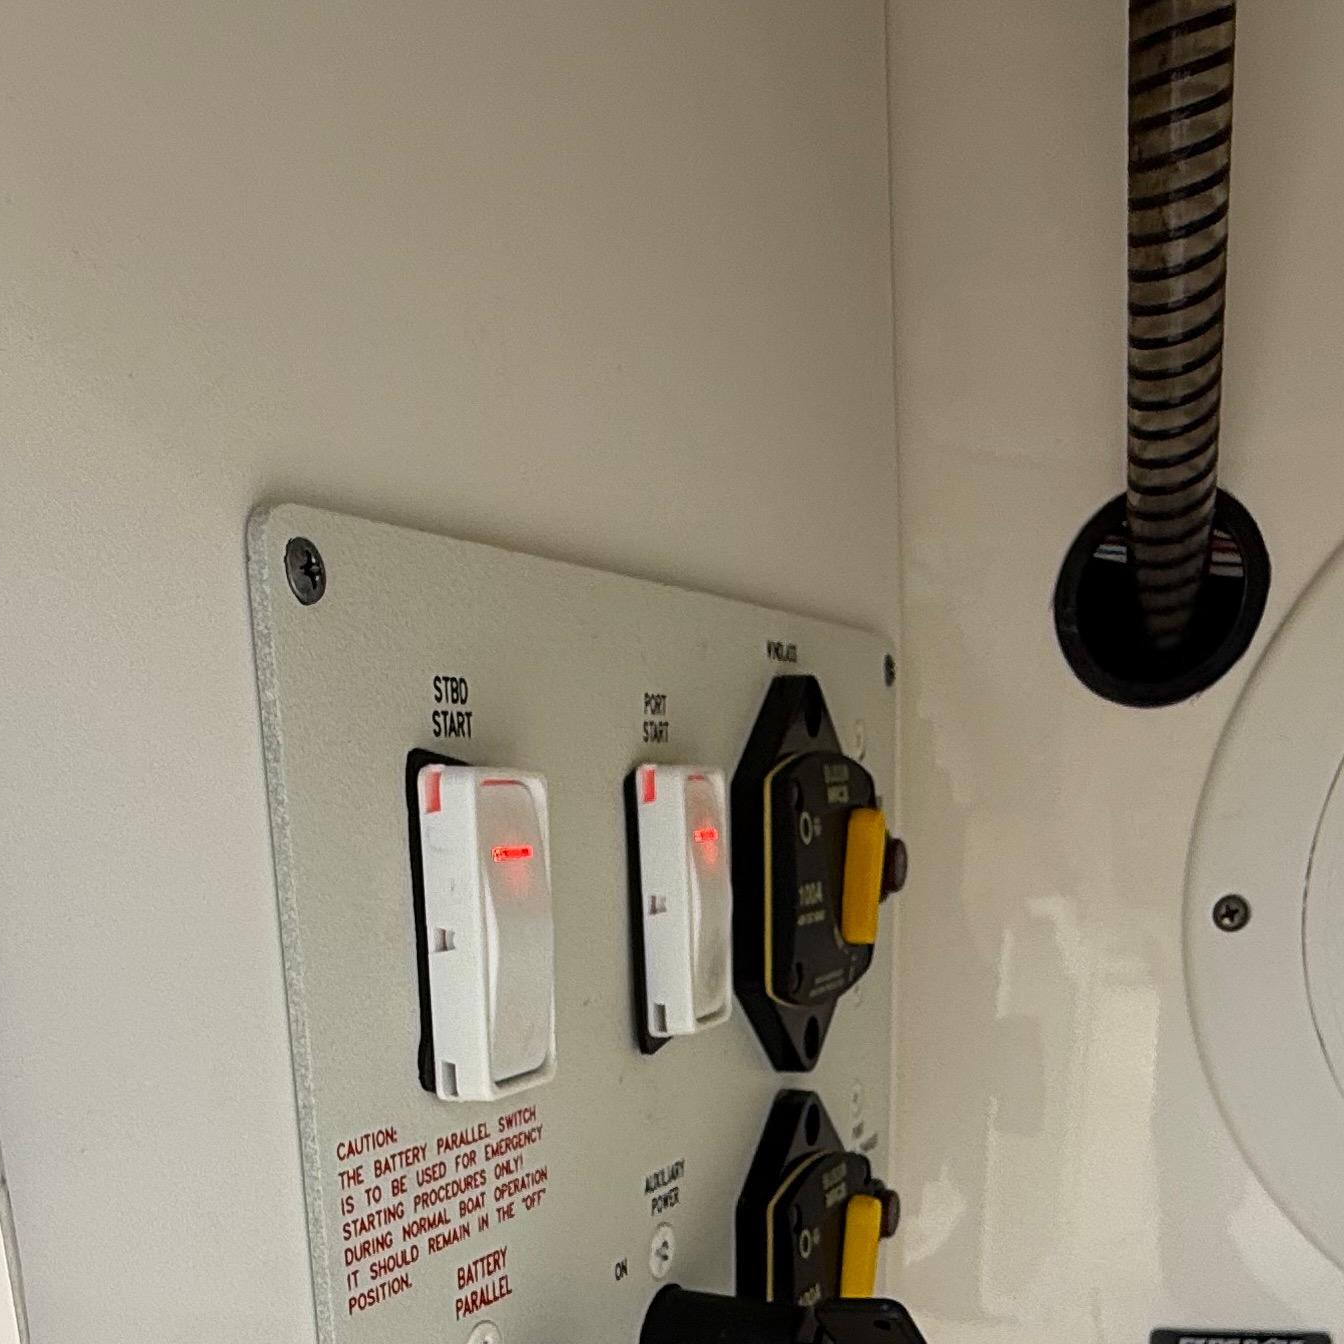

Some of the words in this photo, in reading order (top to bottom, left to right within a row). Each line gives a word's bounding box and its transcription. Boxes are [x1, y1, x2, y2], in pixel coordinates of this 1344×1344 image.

[433, 675, 468, 705] STBD
[644, 692, 667, 716] PORT
[432, 710, 472, 738] START
[643, 721, 669, 743] START
[337, 1126, 398, 1162] CAUTION:
[338, 1165, 364, 1191] THE
[374, 1143, 428, 1179] BATTERY
[436, 1122, 491, 1156] PARALLEL
[498, 1105, 537, 1133] SWITCH
[341, 1195, 355, 1216] IS
[365, 1186, 382, 1206] TO
[391, 1175, 407, 1197] BE
[416, 1161, 447, 1187] USED
[455, 1150, 477, 1173] FOR
[485, 1124, 544, 1162] EMERGENCY
[343, 1202, 405, 1242] STARTING
[413, 1169, 487, 1213] PROCEDURES
[494, 1154, 524, 1180] ONLY!
[344, 1232, 393, 1267] DURING
[402, 1208, 451, 1242] NORMAL
[459, 1192, 486, 1218] BOAT
[494, 1166, 548, 1203] OPERATION
[347, 1270, 360, 1292] IT
[369, 1244, 419, 1280] SHOULD
[428, 1222, 471, 1255] REMAIN
[478, 1213, 489, 1232] IN
[496, 1202, 515, 1223] THE
[457, 1245, 508, 1290] BATTERY
[615, 1258, 628, 1280] ON
[349, 1273, 413, 1316] POSITION.
[456, 1274, 513, 1320] PARALLEL
